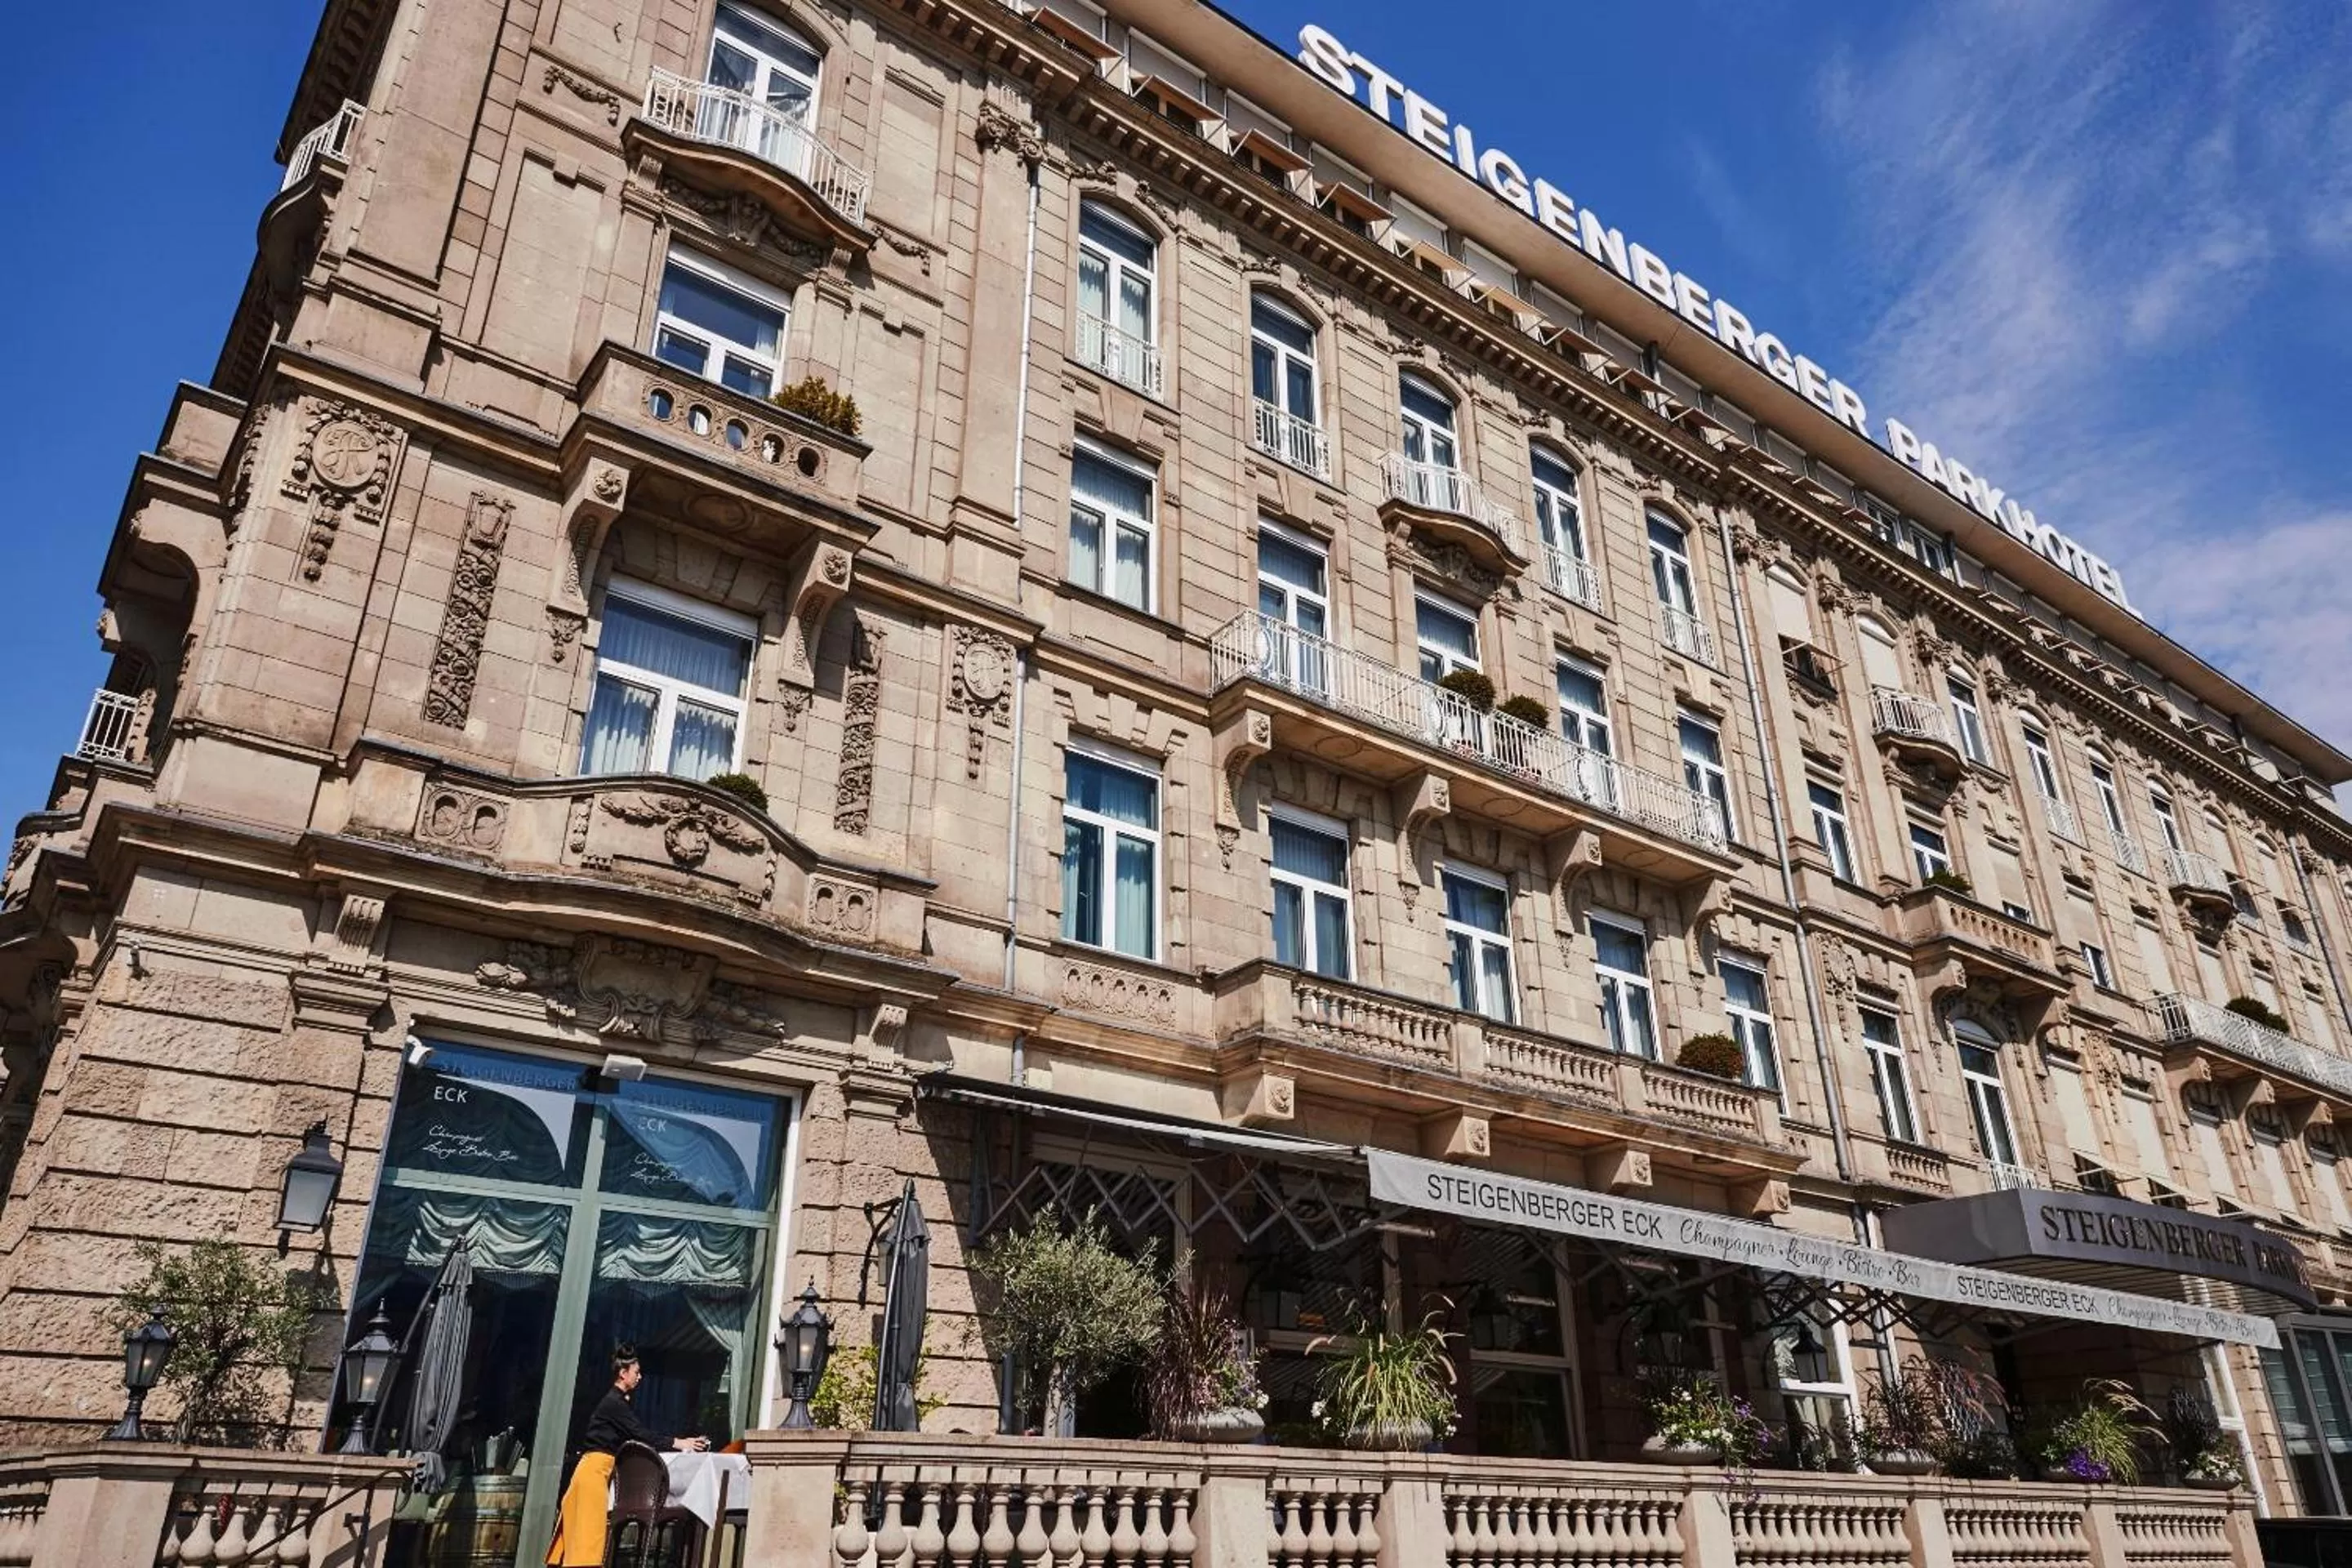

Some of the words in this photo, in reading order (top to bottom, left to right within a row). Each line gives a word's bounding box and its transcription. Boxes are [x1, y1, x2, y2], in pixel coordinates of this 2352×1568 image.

[1298, 24, 1870, 439] STEIGENBERGER
[1886, 417, 2144, 621] PARKHOTEL
[434, 1085, 469, 1103] ECK
[1428, 1174, 1616, 1231] STEIGENBERGER
[1622, 1209, 1664, 1240] ECK
[1785, 1238, 1834, 1270] Lounge
[1842, 1249, 1884, 1279] Bistro
[1892, 1259, 1921, 1285] Bar
[2041, 1205, 2247, 1268] STEIGENBERGER
[1957, 1275, 2069, 1310] STEIGENBERGER
[2071, 1293, 2099, 1313] ECK
